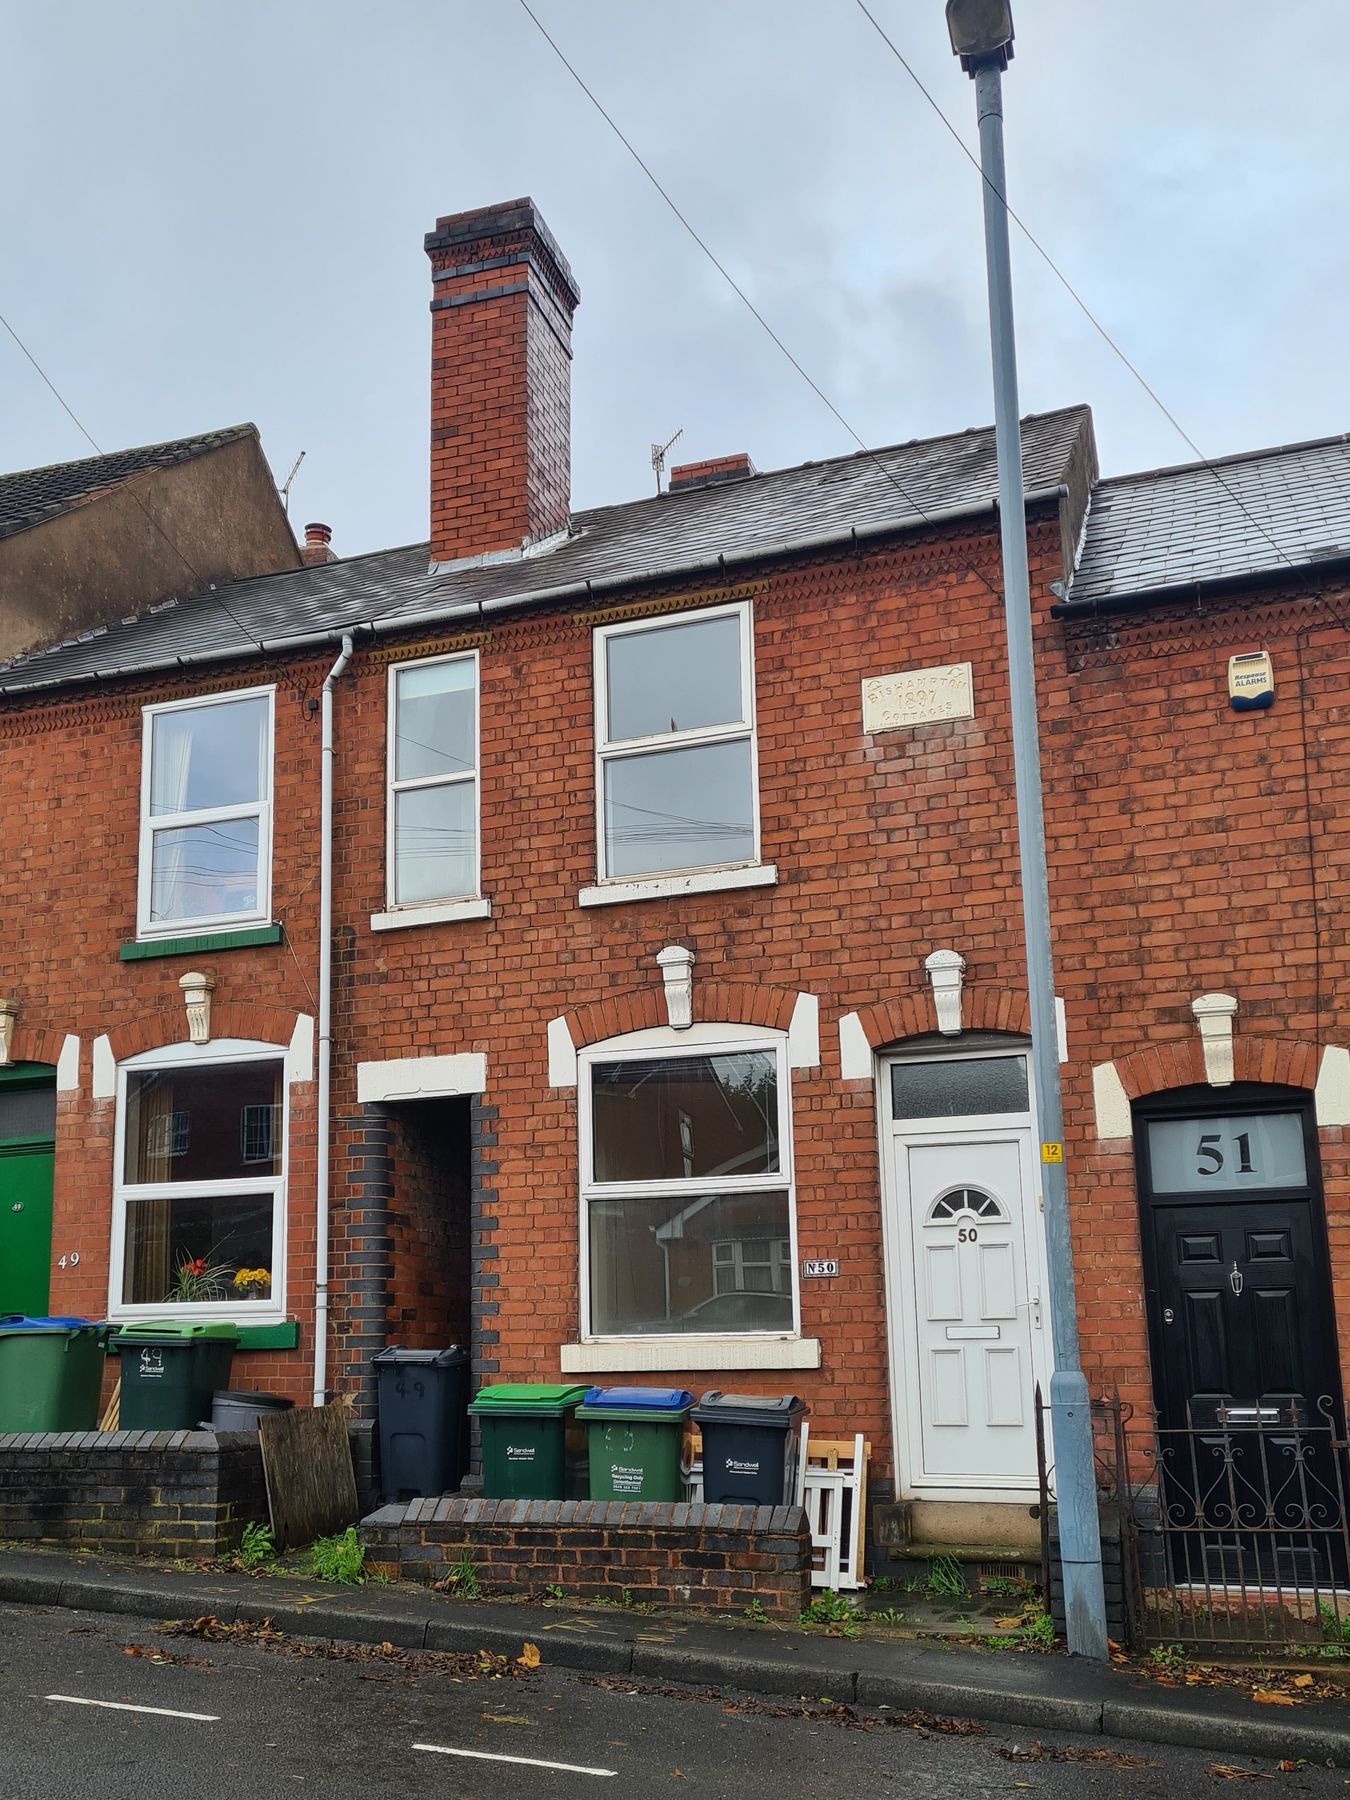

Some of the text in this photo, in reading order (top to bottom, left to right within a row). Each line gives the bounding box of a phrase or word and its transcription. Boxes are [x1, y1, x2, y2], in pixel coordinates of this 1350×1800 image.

[1235, 677, 1267, 688] ALARMS
[898, 689, 937, 709] 1897
[882, 701, 953, 721] COTTAGES
[1045, 1144, 1059, 1156] 12
[1196, 1132, 1258, 1176] 51
[958, 1228, 978, 1243] 50
[58, 1252, 80, 1270] 49
[395, 1380, 425, 1399] 49
